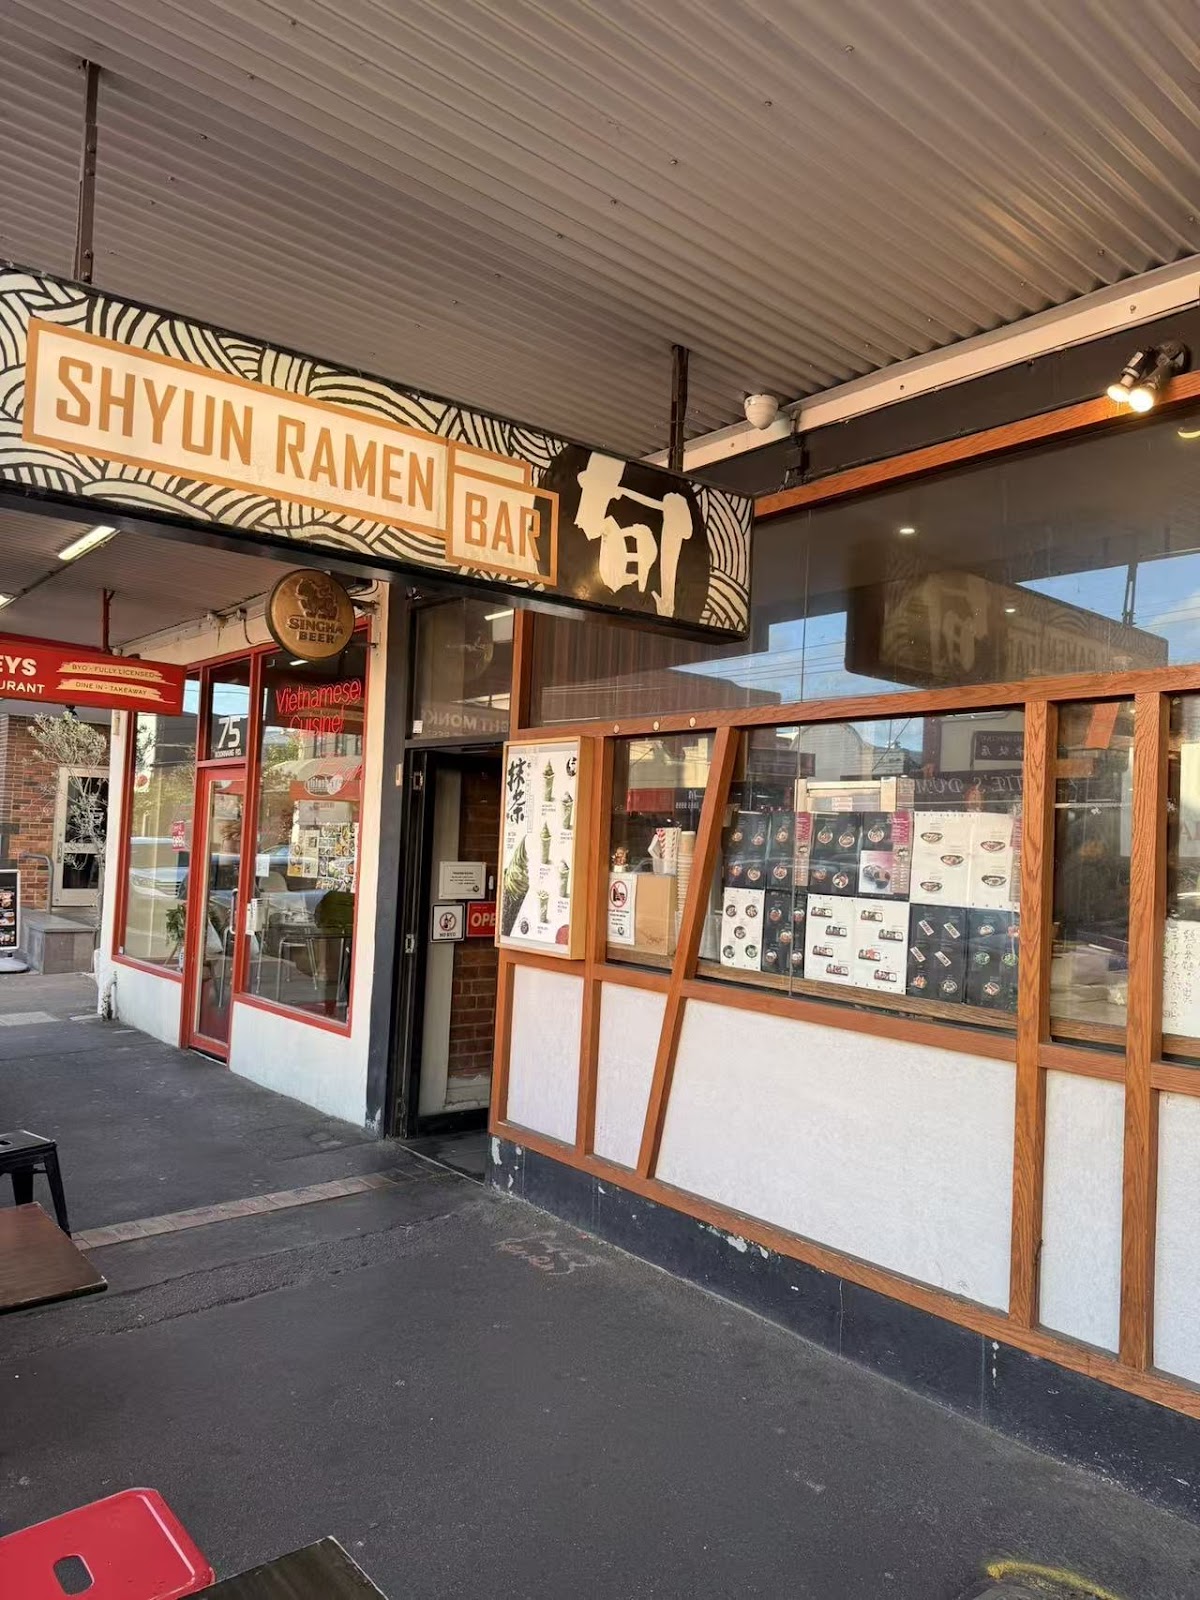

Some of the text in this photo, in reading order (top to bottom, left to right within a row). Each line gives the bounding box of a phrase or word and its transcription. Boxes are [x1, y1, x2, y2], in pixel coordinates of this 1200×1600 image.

[56, 356, 434, 511] SHYUN RAMEN
[465, 491, 541, 561] BAR
[287, 616, 344, 635] SINGHA
[298, 631, 335, 644] BEER
[72, 664, 88, 672] BYO
[94, 666, 118, 674] FULLY
[119, 668, 155, 679] LICENSED
[75, 681, 93, 690] DINE
[95, 683, 103, 691] IN
[110, 685, 147, 696] TAKEAWAY
[275, 679, 361, 714] Vietnamese
[217, 715, 241, 749] 75
[507, 757, 526, 824] 抹茶
